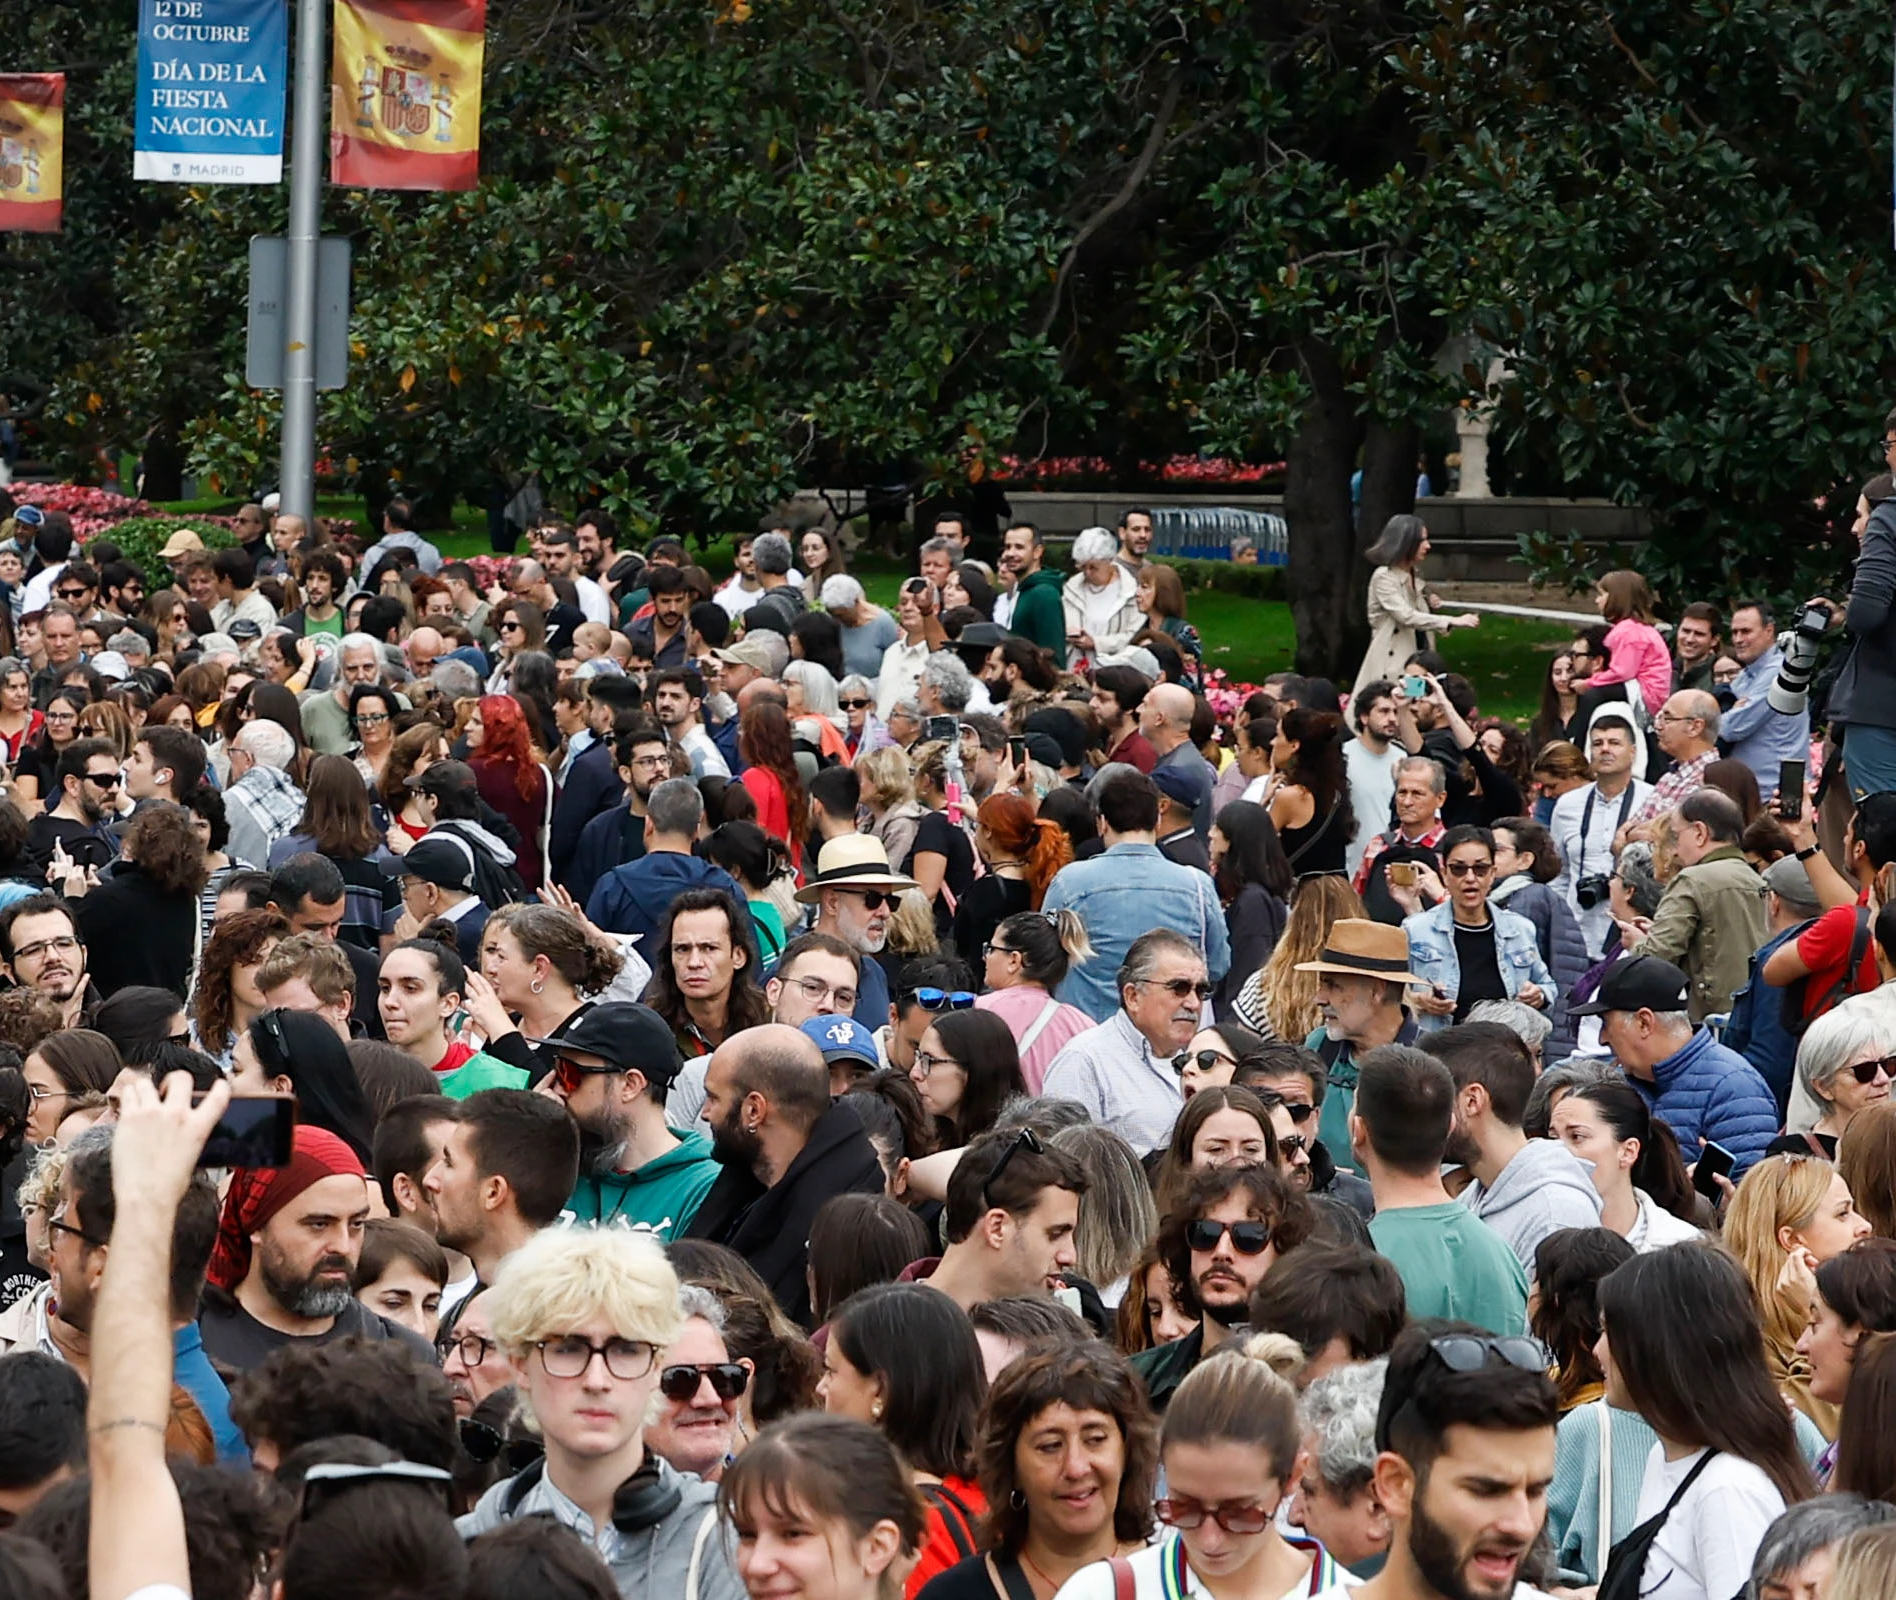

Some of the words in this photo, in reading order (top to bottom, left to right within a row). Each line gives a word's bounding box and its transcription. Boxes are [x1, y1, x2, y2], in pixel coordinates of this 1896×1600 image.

[154, 1, 171, 17] 12
[175, 2, 203, 18] DE
[152, 23, 250, 43] OCTUBRE
[152, 57, 195, 82] DÍA
[199, 63, 232, 83] DE
[235, 63, 266, 83] LA
[151, 88, 229, 109] FIESTA
[150, 116, 274, 138] NACIONAL
[189, 164, 245, 177] MADRID
